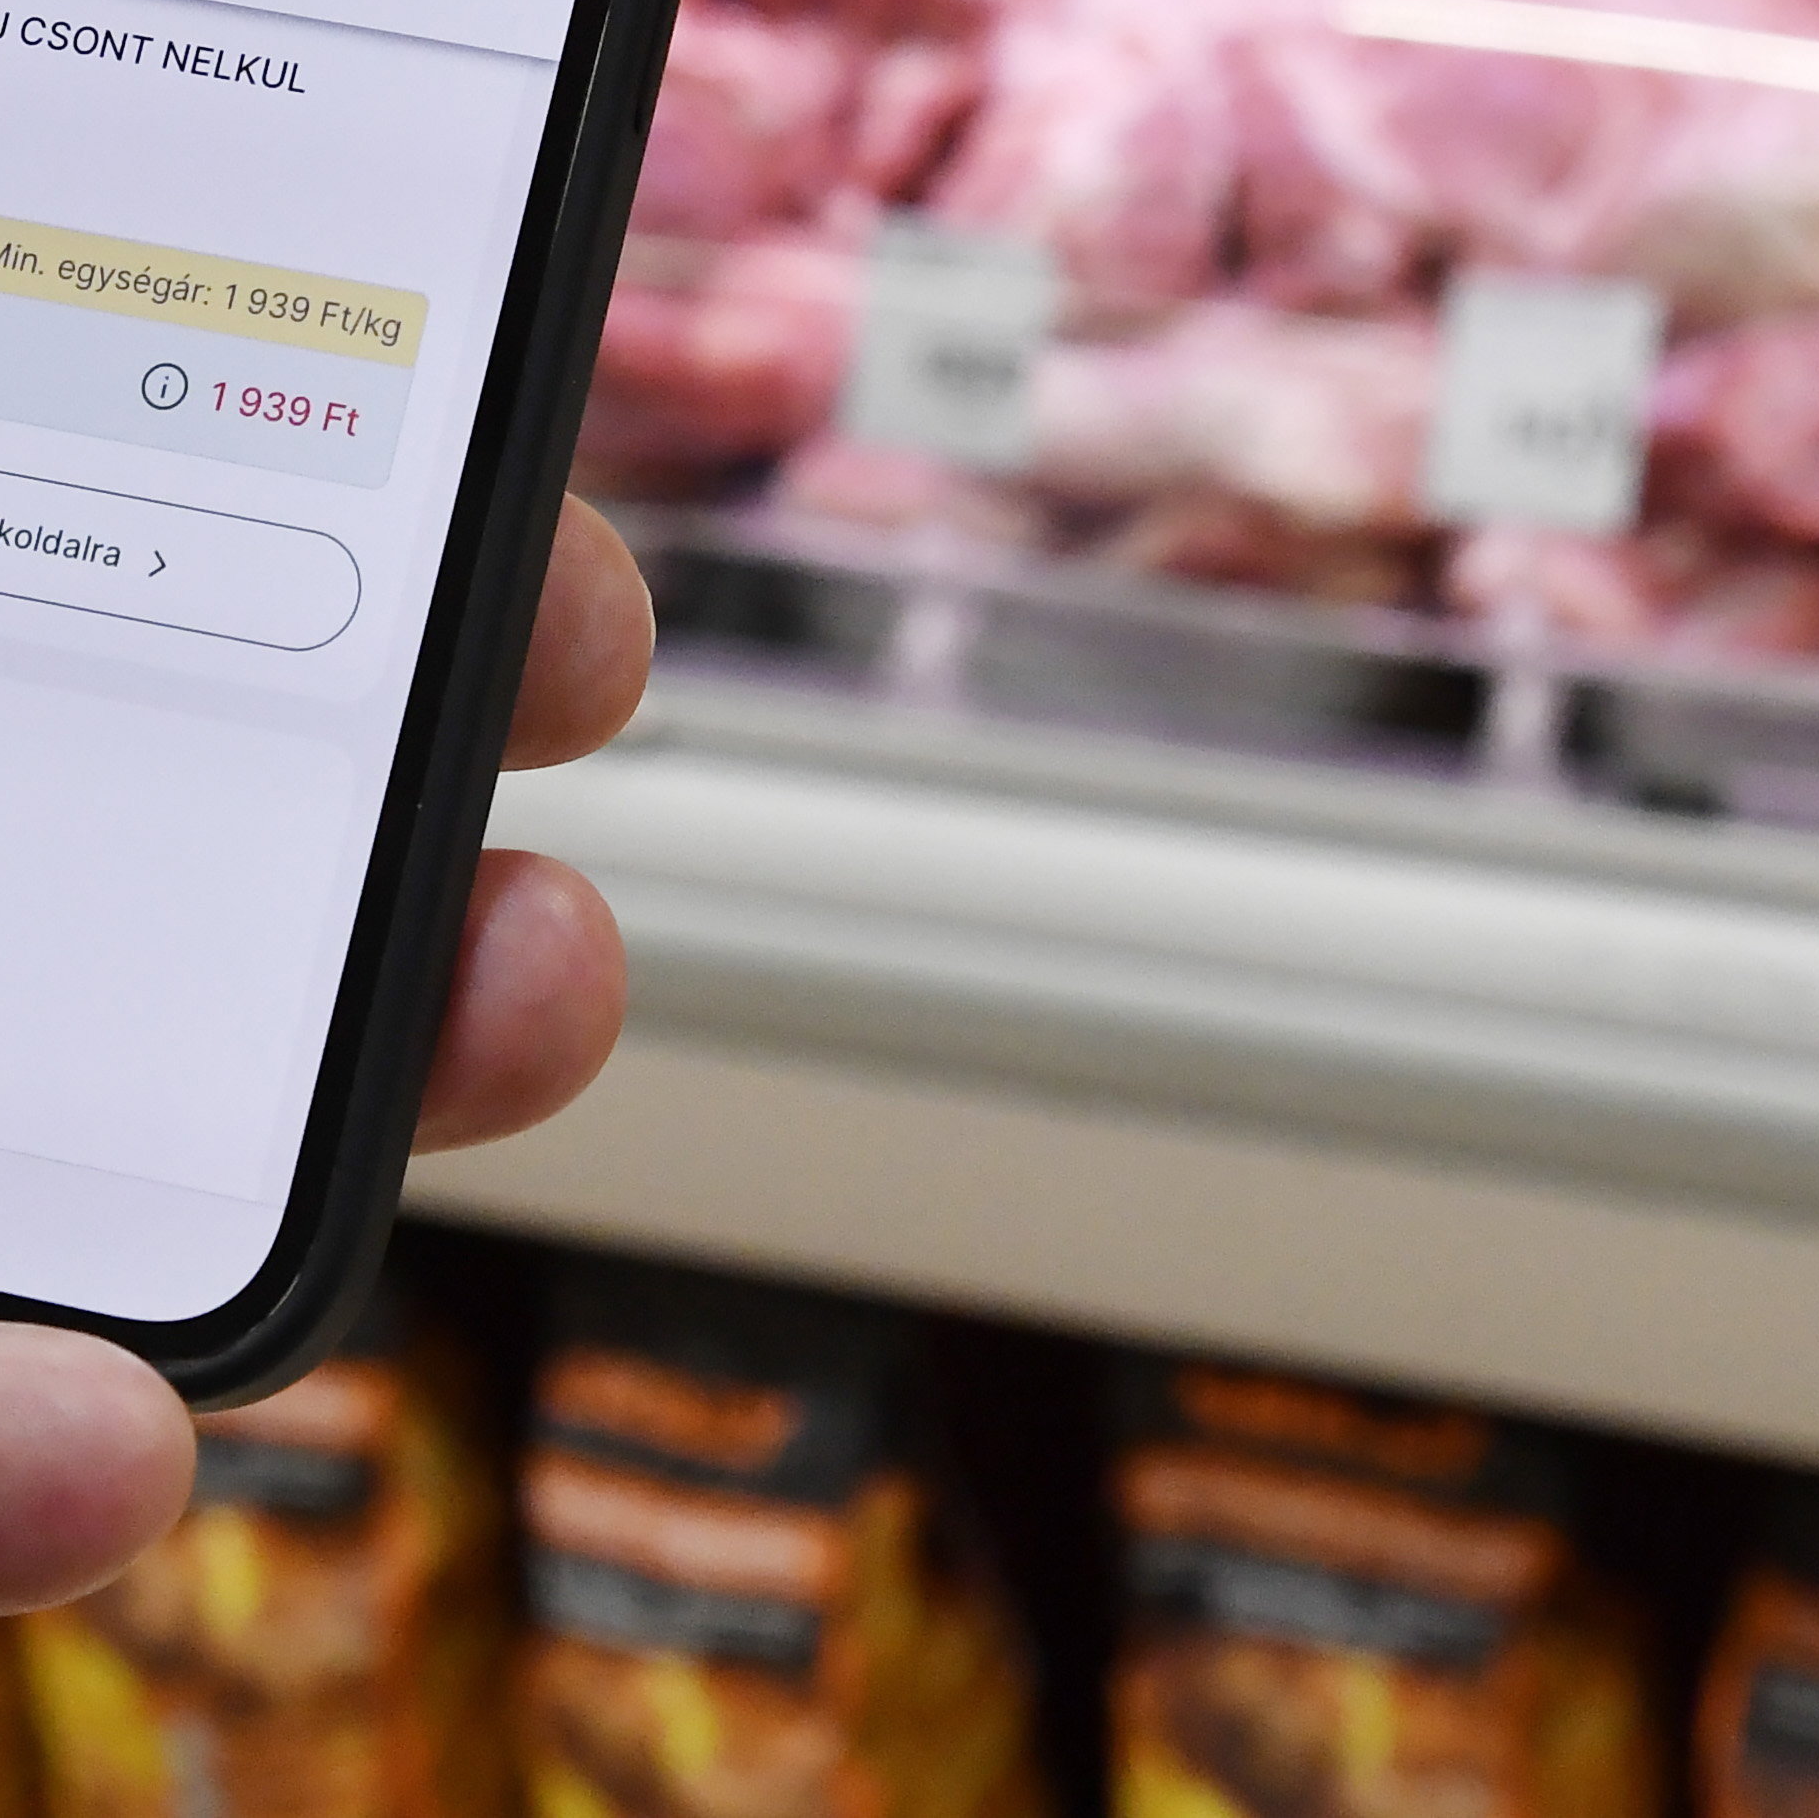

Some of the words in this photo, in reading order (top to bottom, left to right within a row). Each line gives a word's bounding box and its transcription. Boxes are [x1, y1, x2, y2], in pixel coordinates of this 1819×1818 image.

[20, 16, 155, 65] CSONT
[162, 40, 306, 94] NELKUL
[58, 259, 212, 306] egységár:
[319, 300, 402, 347] Ft/kg
[322, 401, 360, 437] Ft
